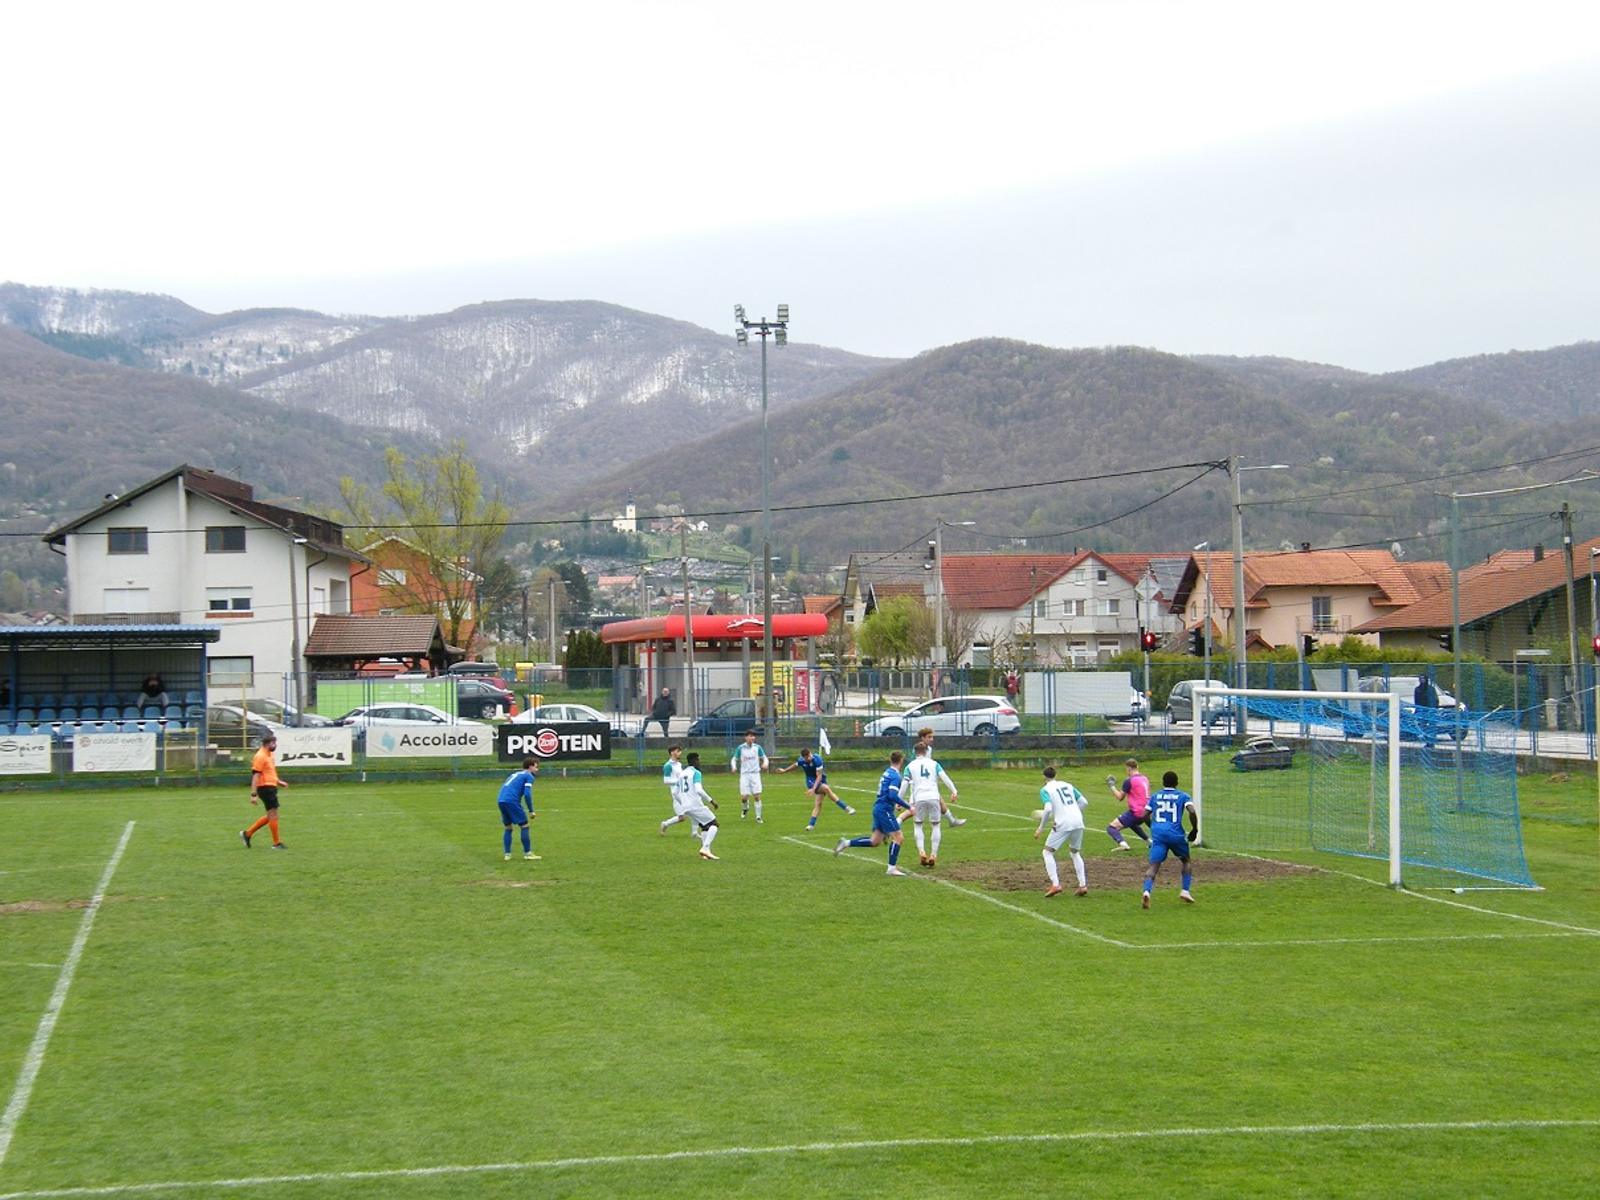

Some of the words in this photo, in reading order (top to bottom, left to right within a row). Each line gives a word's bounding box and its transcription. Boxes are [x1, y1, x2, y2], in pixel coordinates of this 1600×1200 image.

[400, 732, 478, 746] Accolade
[507, 728, 602, 757] PROTEIN
[920, 764, 930, 779] 4
[1056, 786, 1074, 805] 15
[1155, 800, 1178, 823] 24
